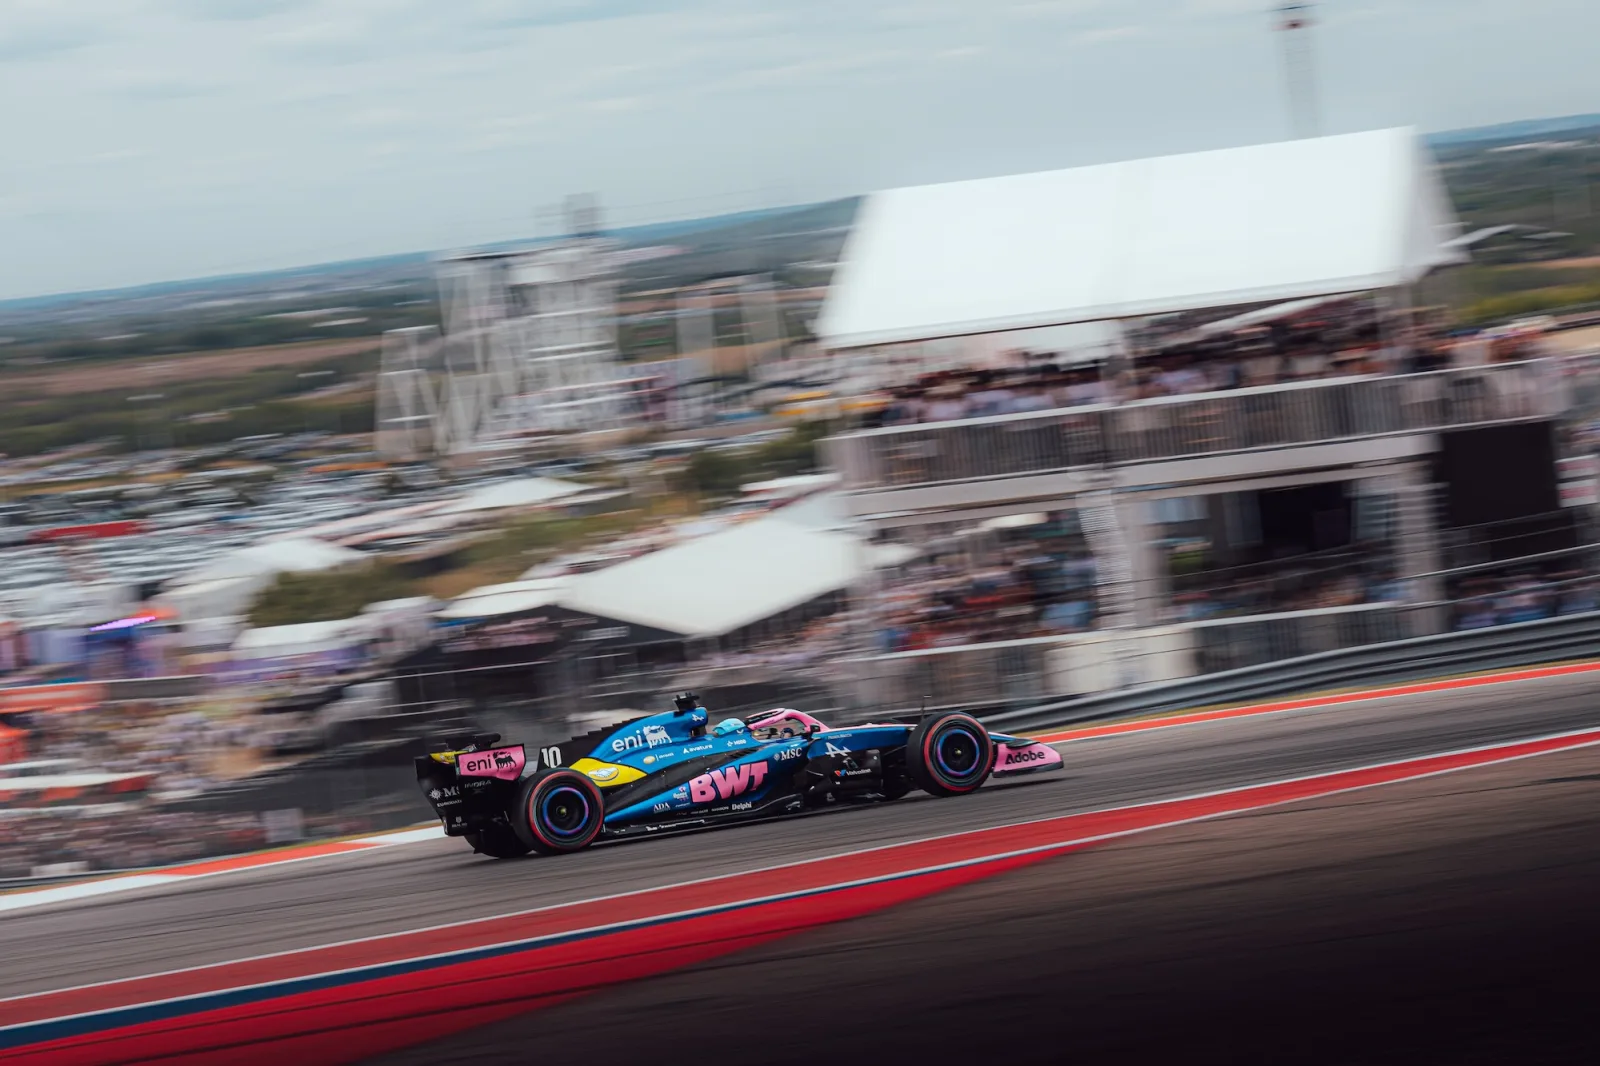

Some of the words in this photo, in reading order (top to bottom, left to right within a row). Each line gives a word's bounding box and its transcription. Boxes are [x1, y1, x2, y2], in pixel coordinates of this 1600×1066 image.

[612, 729, 643, 752] eni
[541, 746, 562, 769] 10
[780, 747, 802, 761] MSC
[1005, 750, 1046, 765] Adobe
[466, 754, 492, 772] eni
[689, 761, 768, 803] BWT
[653, 801, 671, 811] ADA
[731, 801, 752, 811] Delphi
